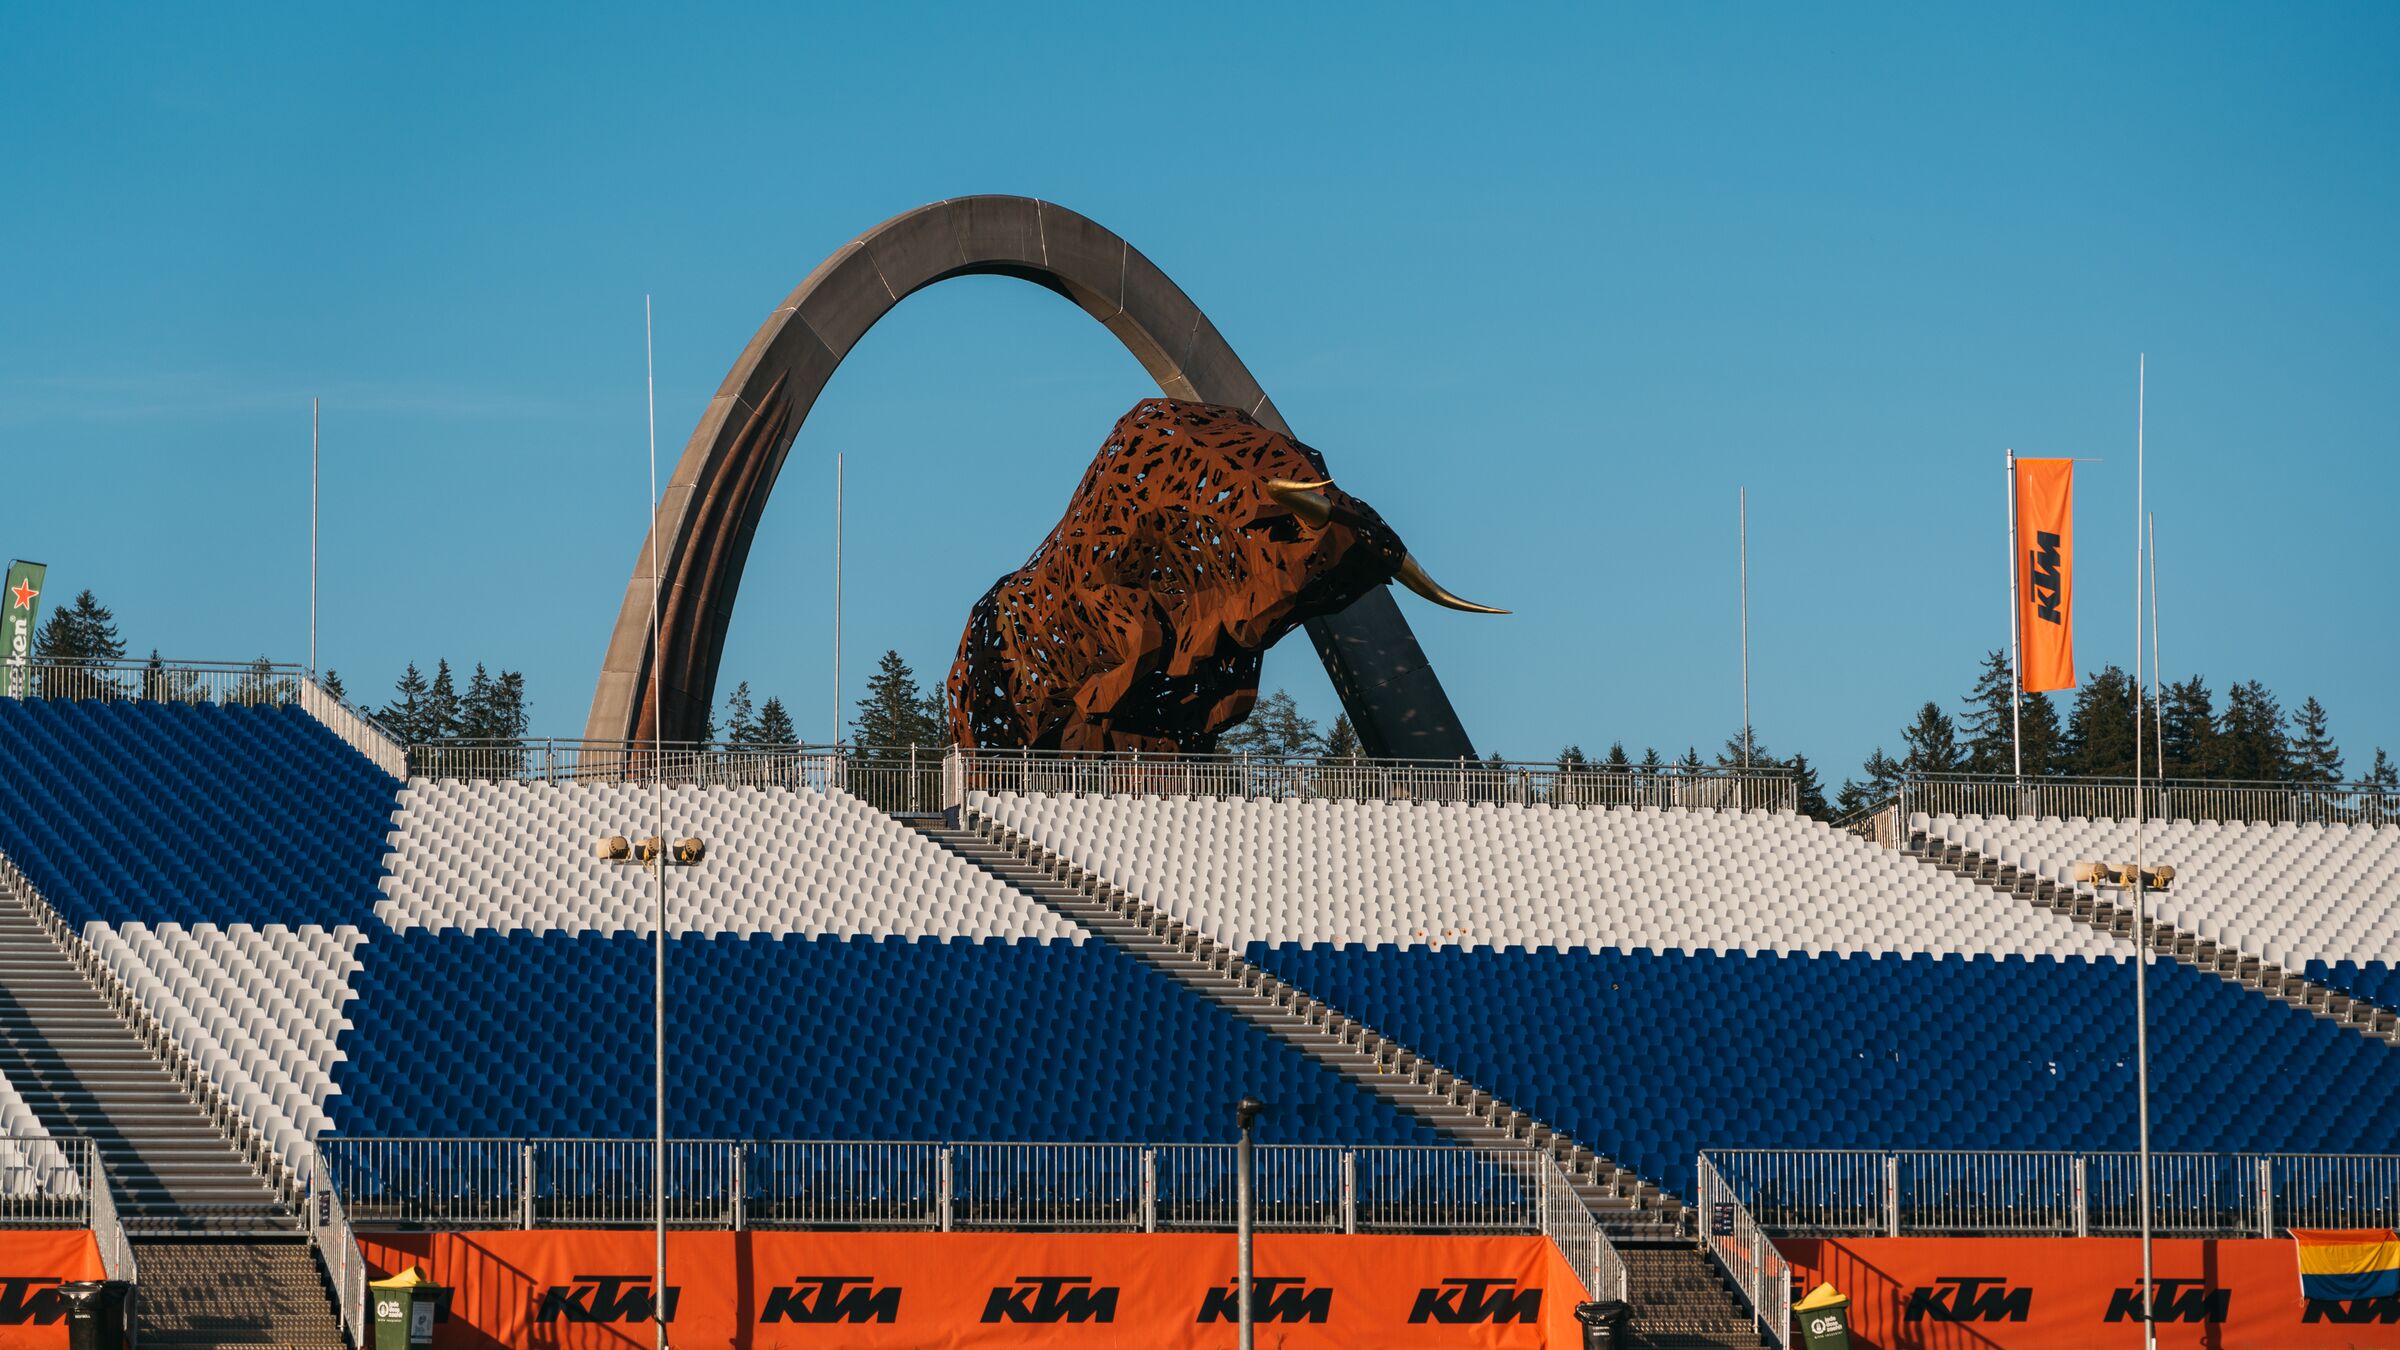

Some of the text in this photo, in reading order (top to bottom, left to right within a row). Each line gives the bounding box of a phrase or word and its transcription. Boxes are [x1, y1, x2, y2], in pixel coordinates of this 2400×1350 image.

[2031, 531, 2061, 625] KTM
[0, 1277, 70, 1325] TM
[536, 1275, 681, 1323] KTM
[760, 1276, 902, 1323] KTM
[980, 1276, 1120, 1323] KTM
[1196, 1276, 1333, 1323] KTM
[1407, 1278, 1543, 1324] KTM
[1904, 1277, 2032, 1323] KTM
[2104, 1278, 2232, 1323] KTM
